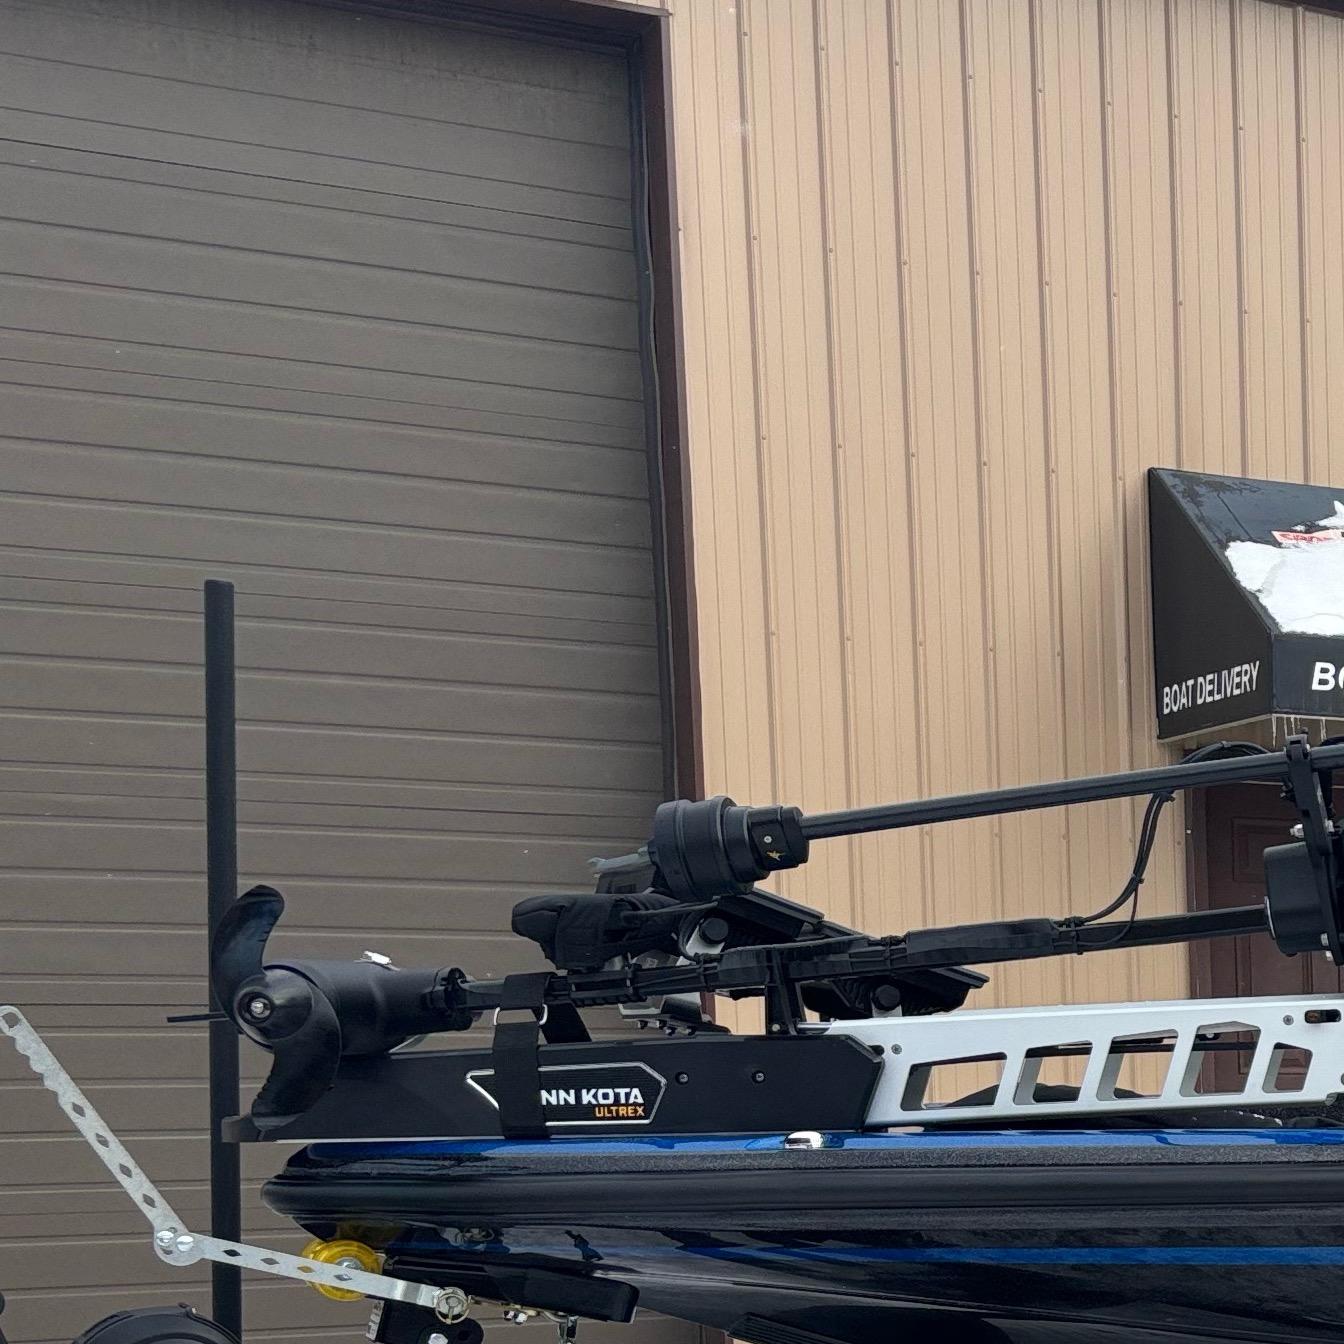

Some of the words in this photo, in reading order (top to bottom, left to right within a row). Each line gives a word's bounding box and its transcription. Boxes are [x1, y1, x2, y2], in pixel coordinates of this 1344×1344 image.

[1162, 679, 1194, 715] BOAT
[1196, 661, 1260, 705] DELIVERY
[539, 1088, 576, 1106] NN
[581, 1087, 645, 1105] KOTA
[594, 1105, 646, 1118] ULTREX
